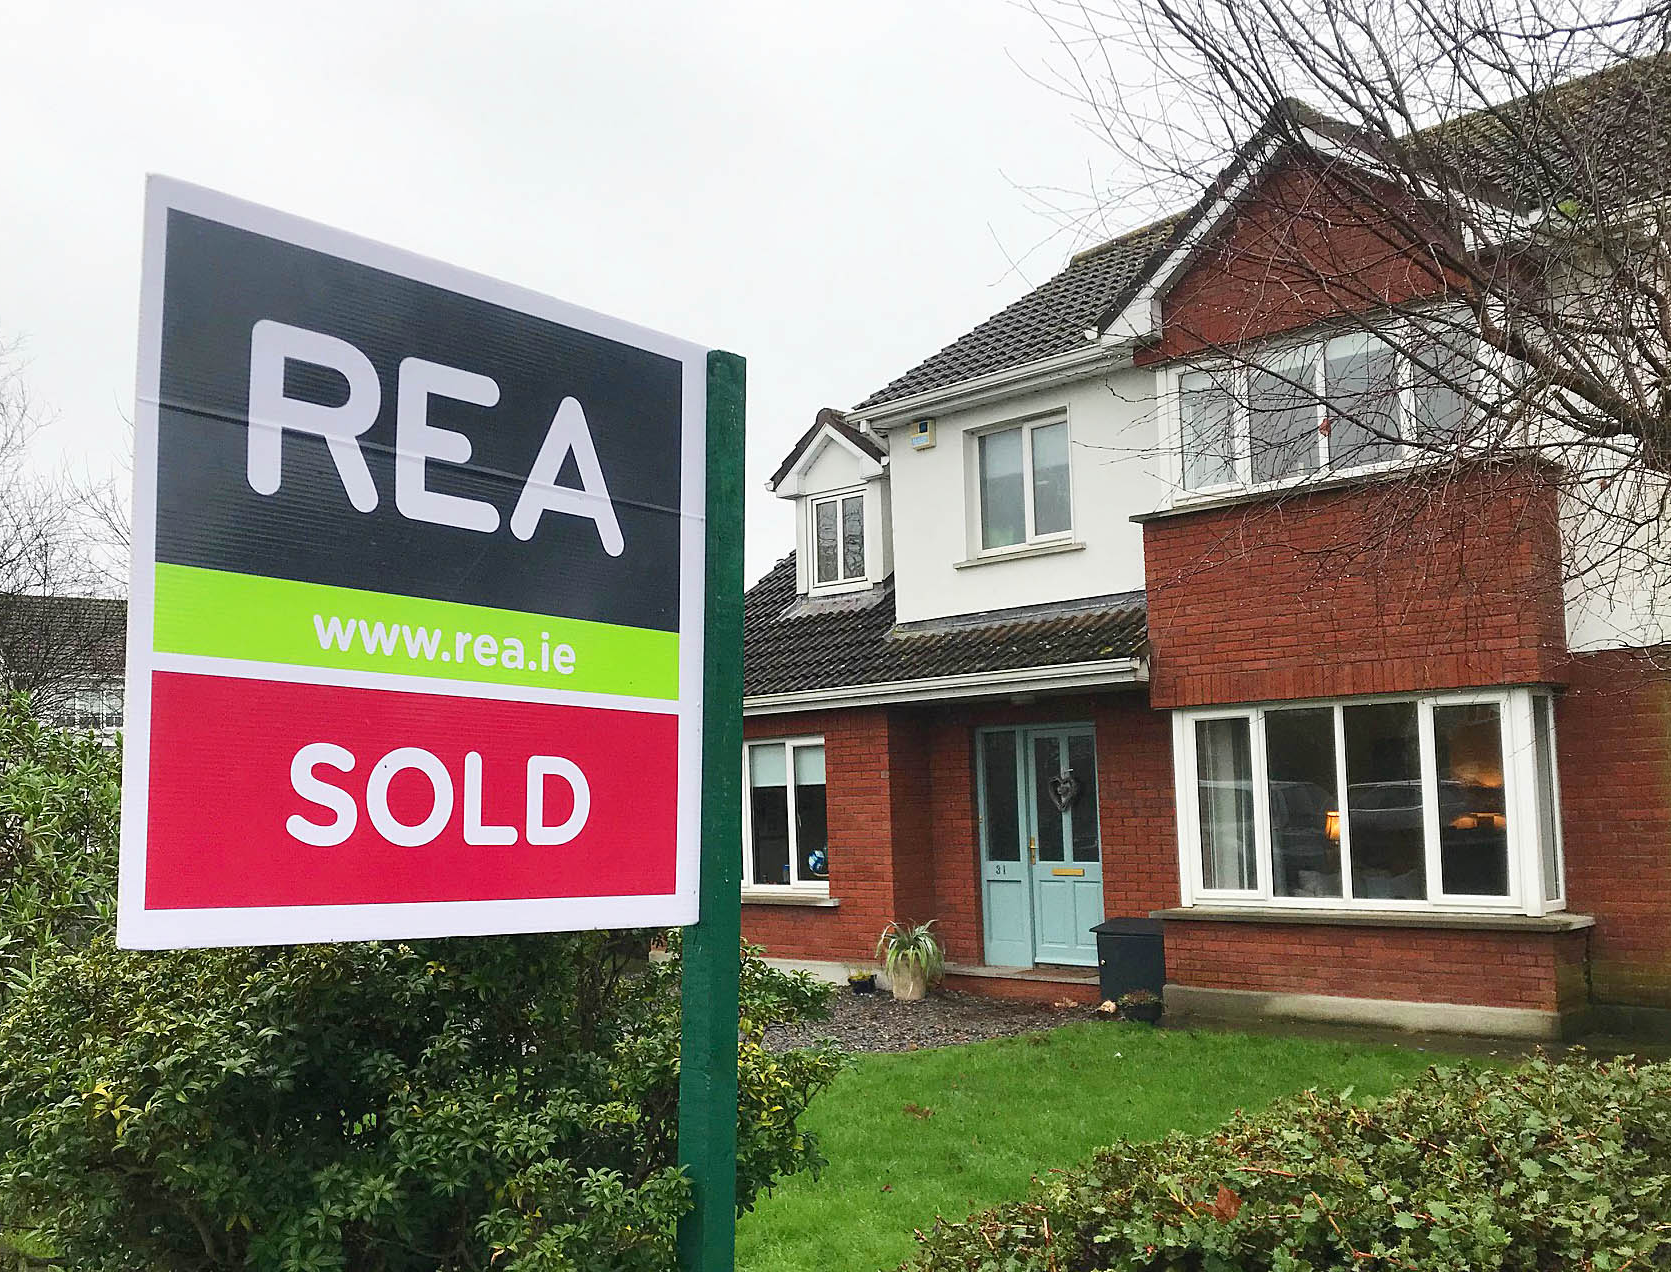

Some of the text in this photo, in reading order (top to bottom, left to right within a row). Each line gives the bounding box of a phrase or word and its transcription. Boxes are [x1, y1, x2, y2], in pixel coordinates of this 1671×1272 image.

[246, 319, 625, 557] REA
[313, 614, 576, 675] www.rea.ie
[285, 742, 591, 848] SOLD
[995, 864, 1006, 875] 31
